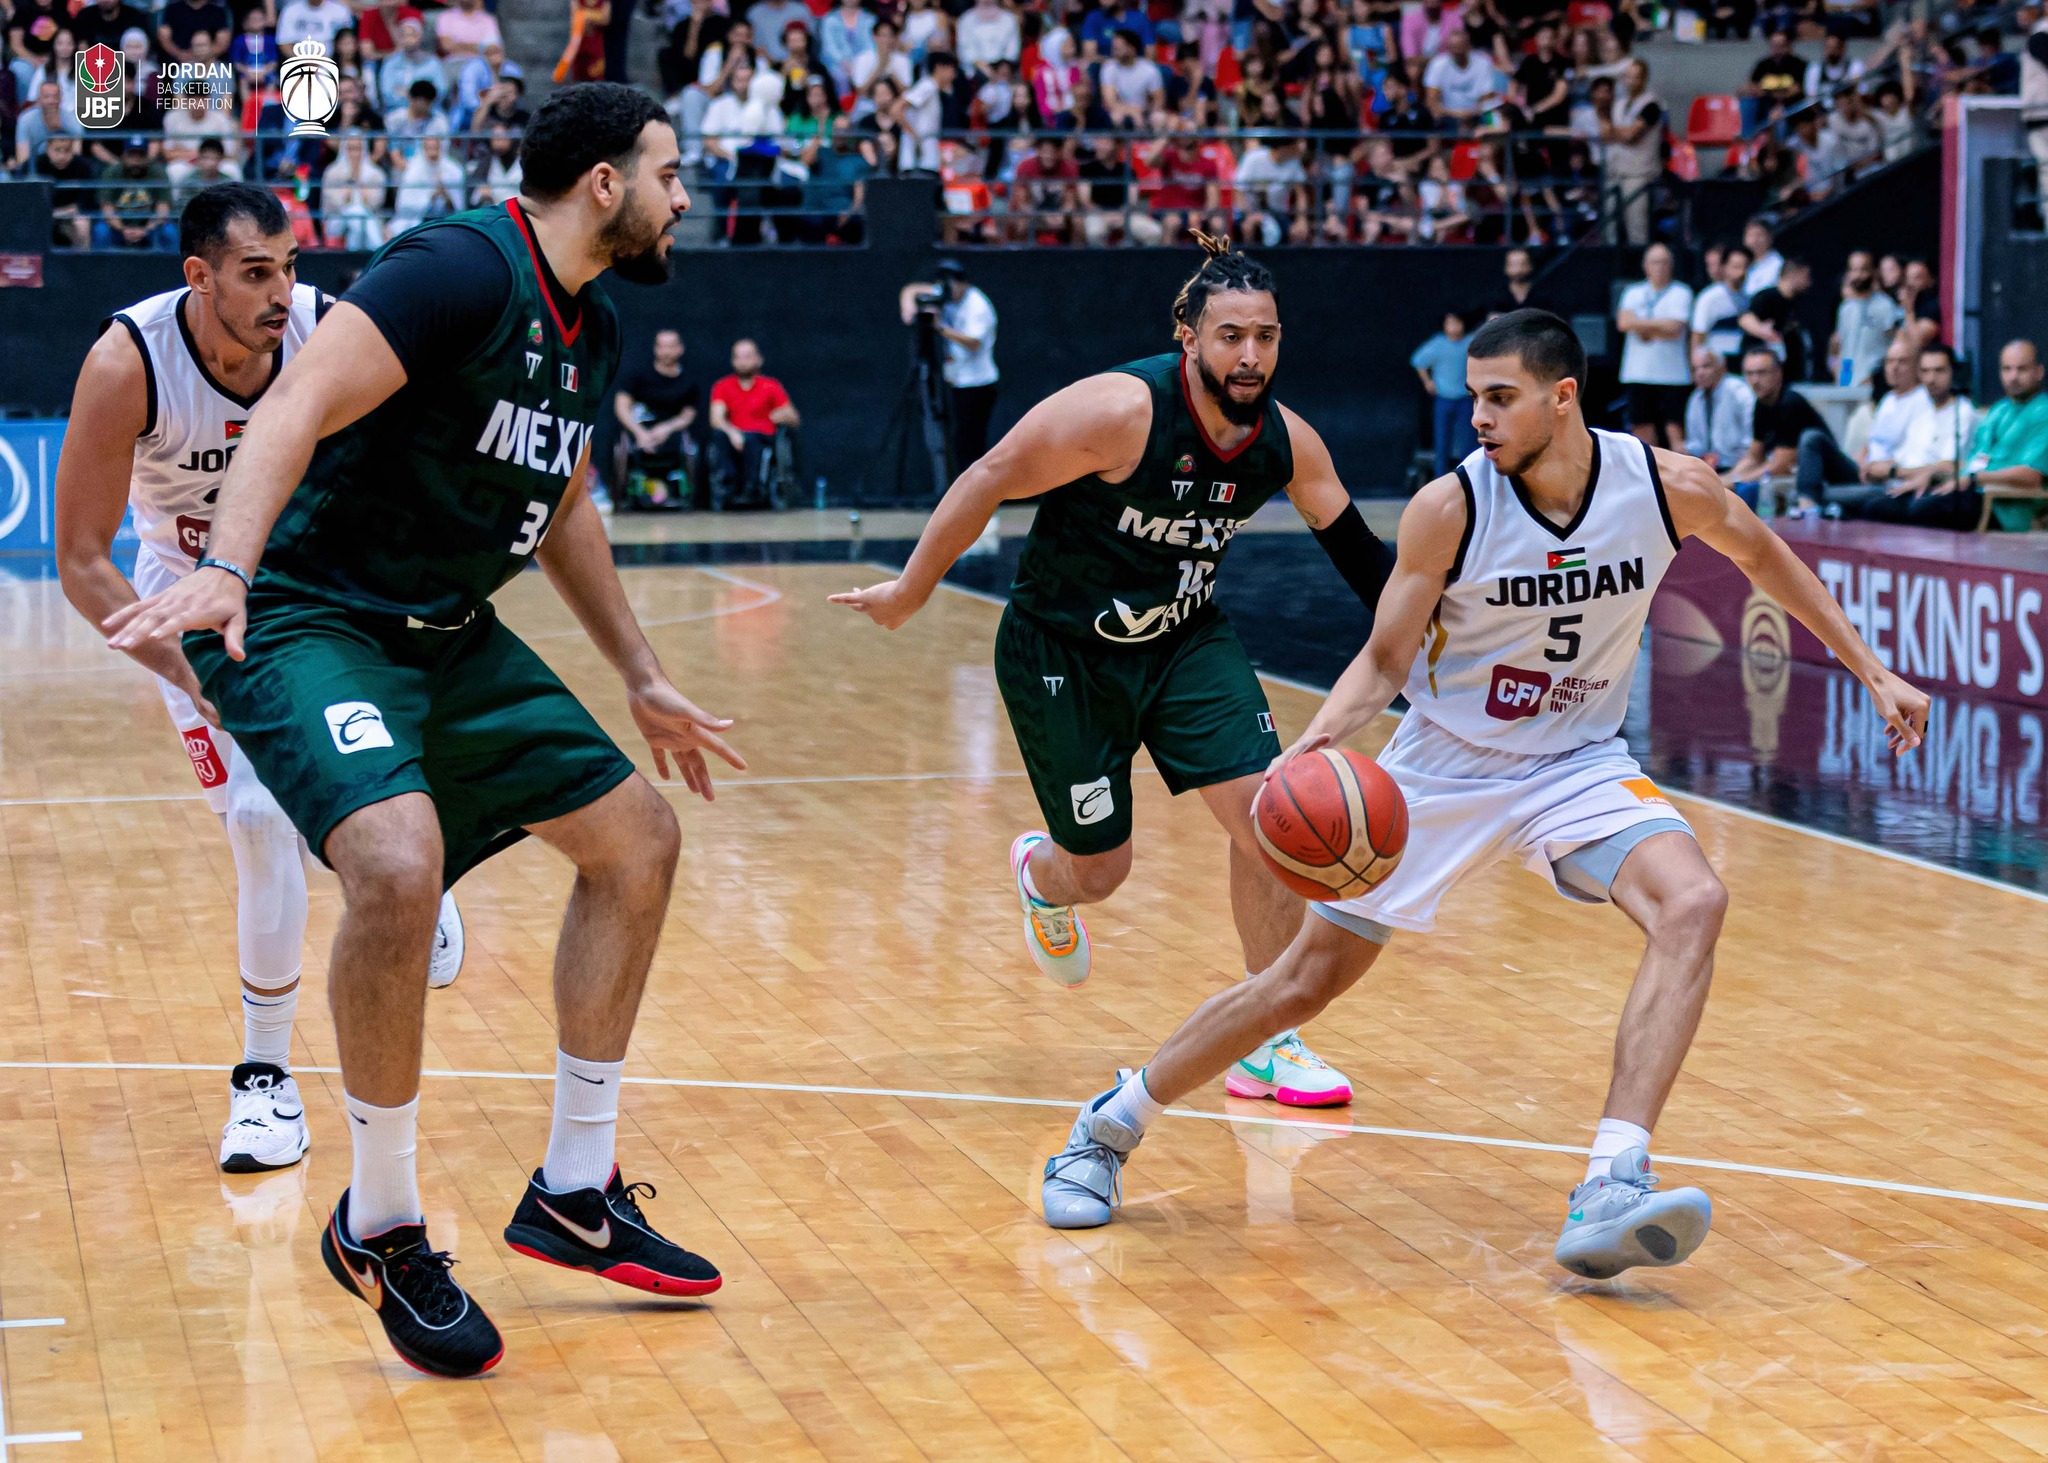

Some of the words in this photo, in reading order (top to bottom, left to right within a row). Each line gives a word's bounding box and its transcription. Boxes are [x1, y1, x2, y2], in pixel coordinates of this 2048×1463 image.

[509, 500, 550, 556] 3
[1485, 556, 1645, 608] JORDAN
[1543, 613, 1584, 663] 5
[1897, 571, 2045, 697] KING'S
[1496, 677, 1542, 708] CFI
